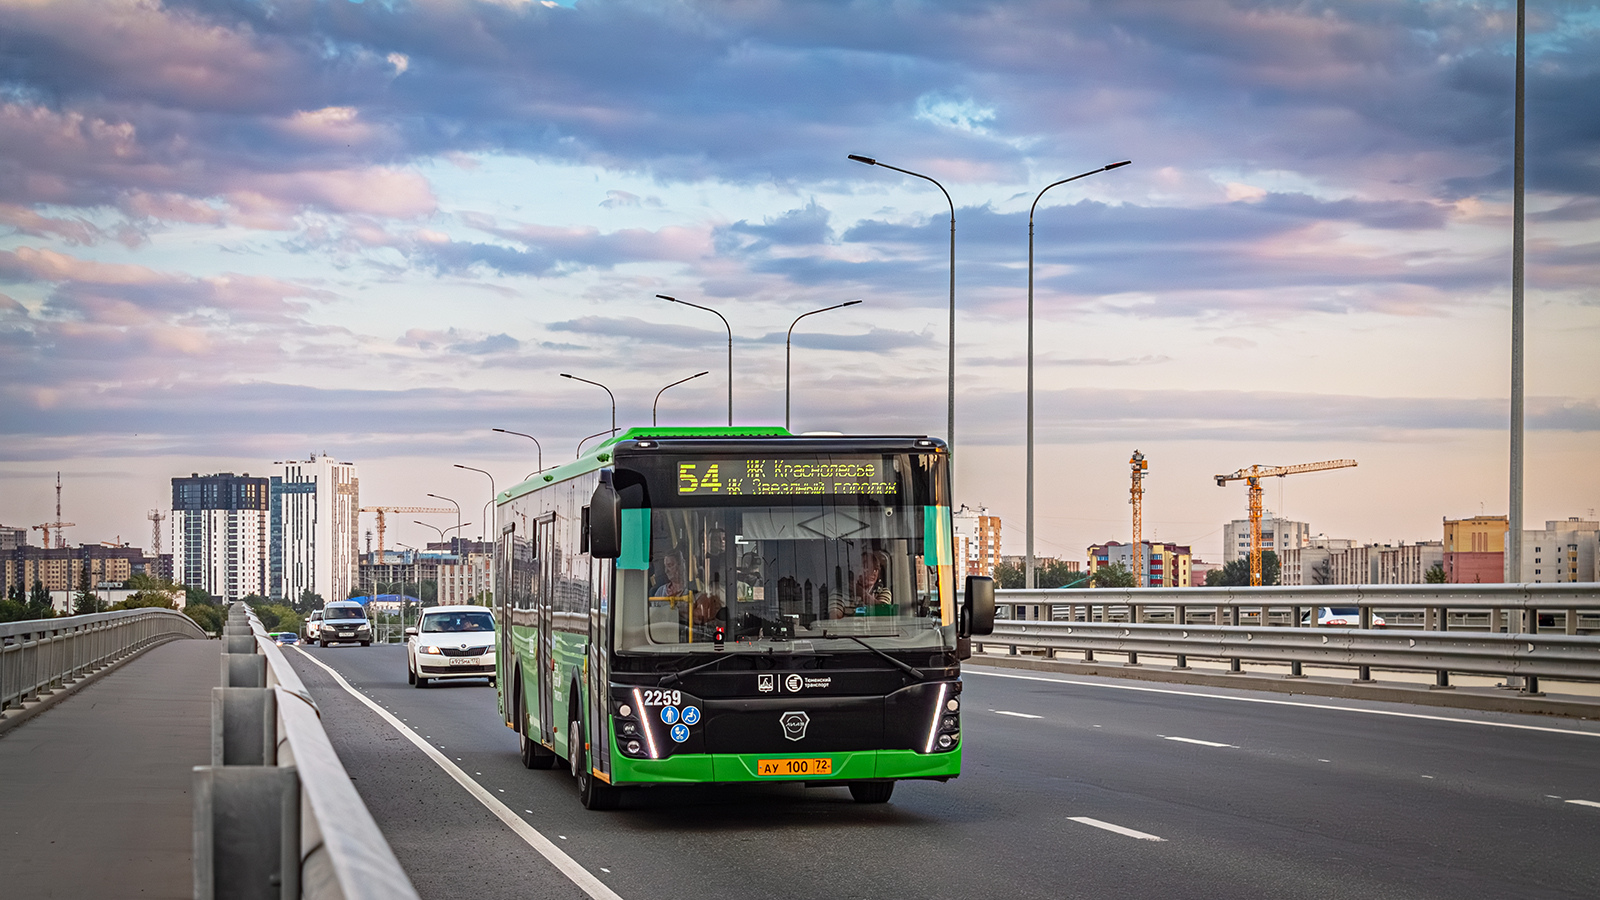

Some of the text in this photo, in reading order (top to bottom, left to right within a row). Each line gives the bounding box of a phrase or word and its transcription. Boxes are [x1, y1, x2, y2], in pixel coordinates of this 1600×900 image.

[746, 460, 875, 478] ЖК Краснолесье
[679, 464, 722, 492] 54
[834, 482, 897, 495] городок
[643, 690, 681, 706] 2259
[764, 760, 827, 773] АУ 100 72
